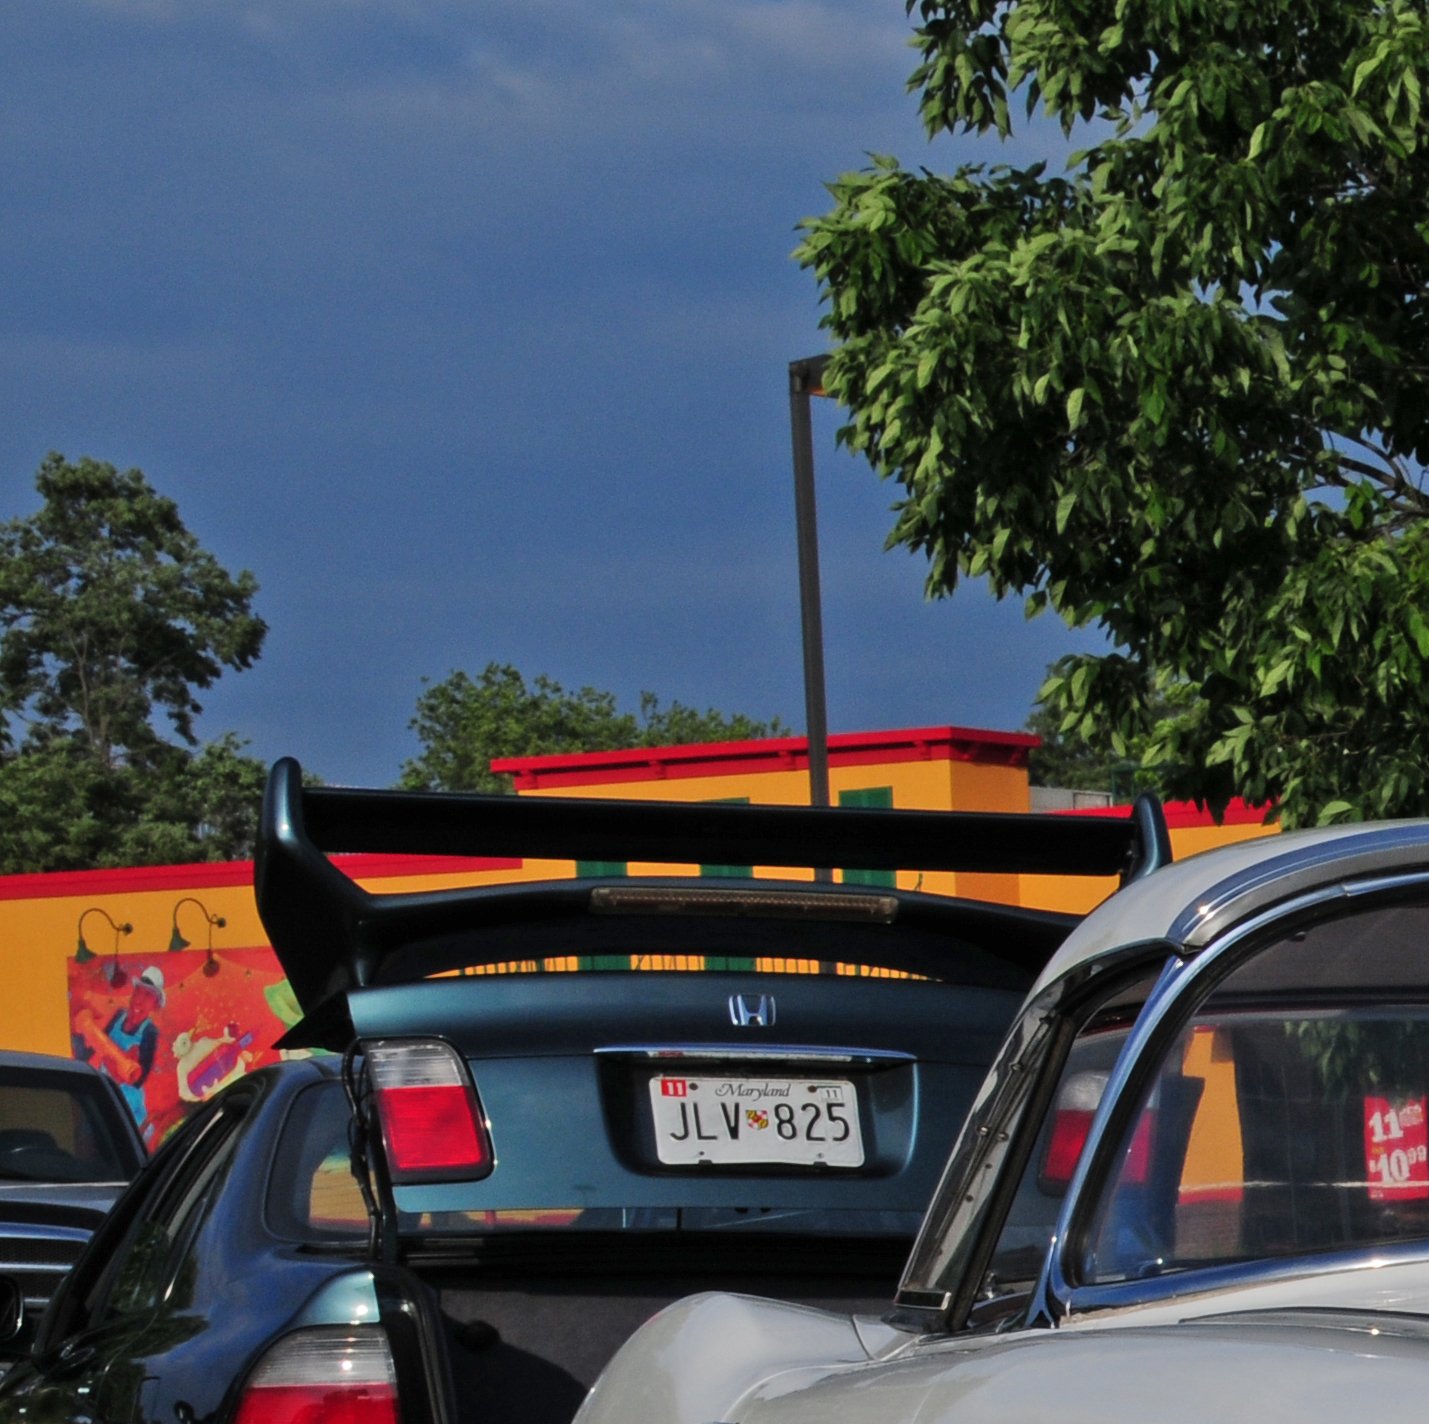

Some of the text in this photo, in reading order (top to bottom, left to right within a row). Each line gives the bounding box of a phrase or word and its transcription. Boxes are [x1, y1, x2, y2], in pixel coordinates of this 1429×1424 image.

[715, 1082, 792, 1101] Maryland
[669, 1101, 850, 1142] JLV 825
